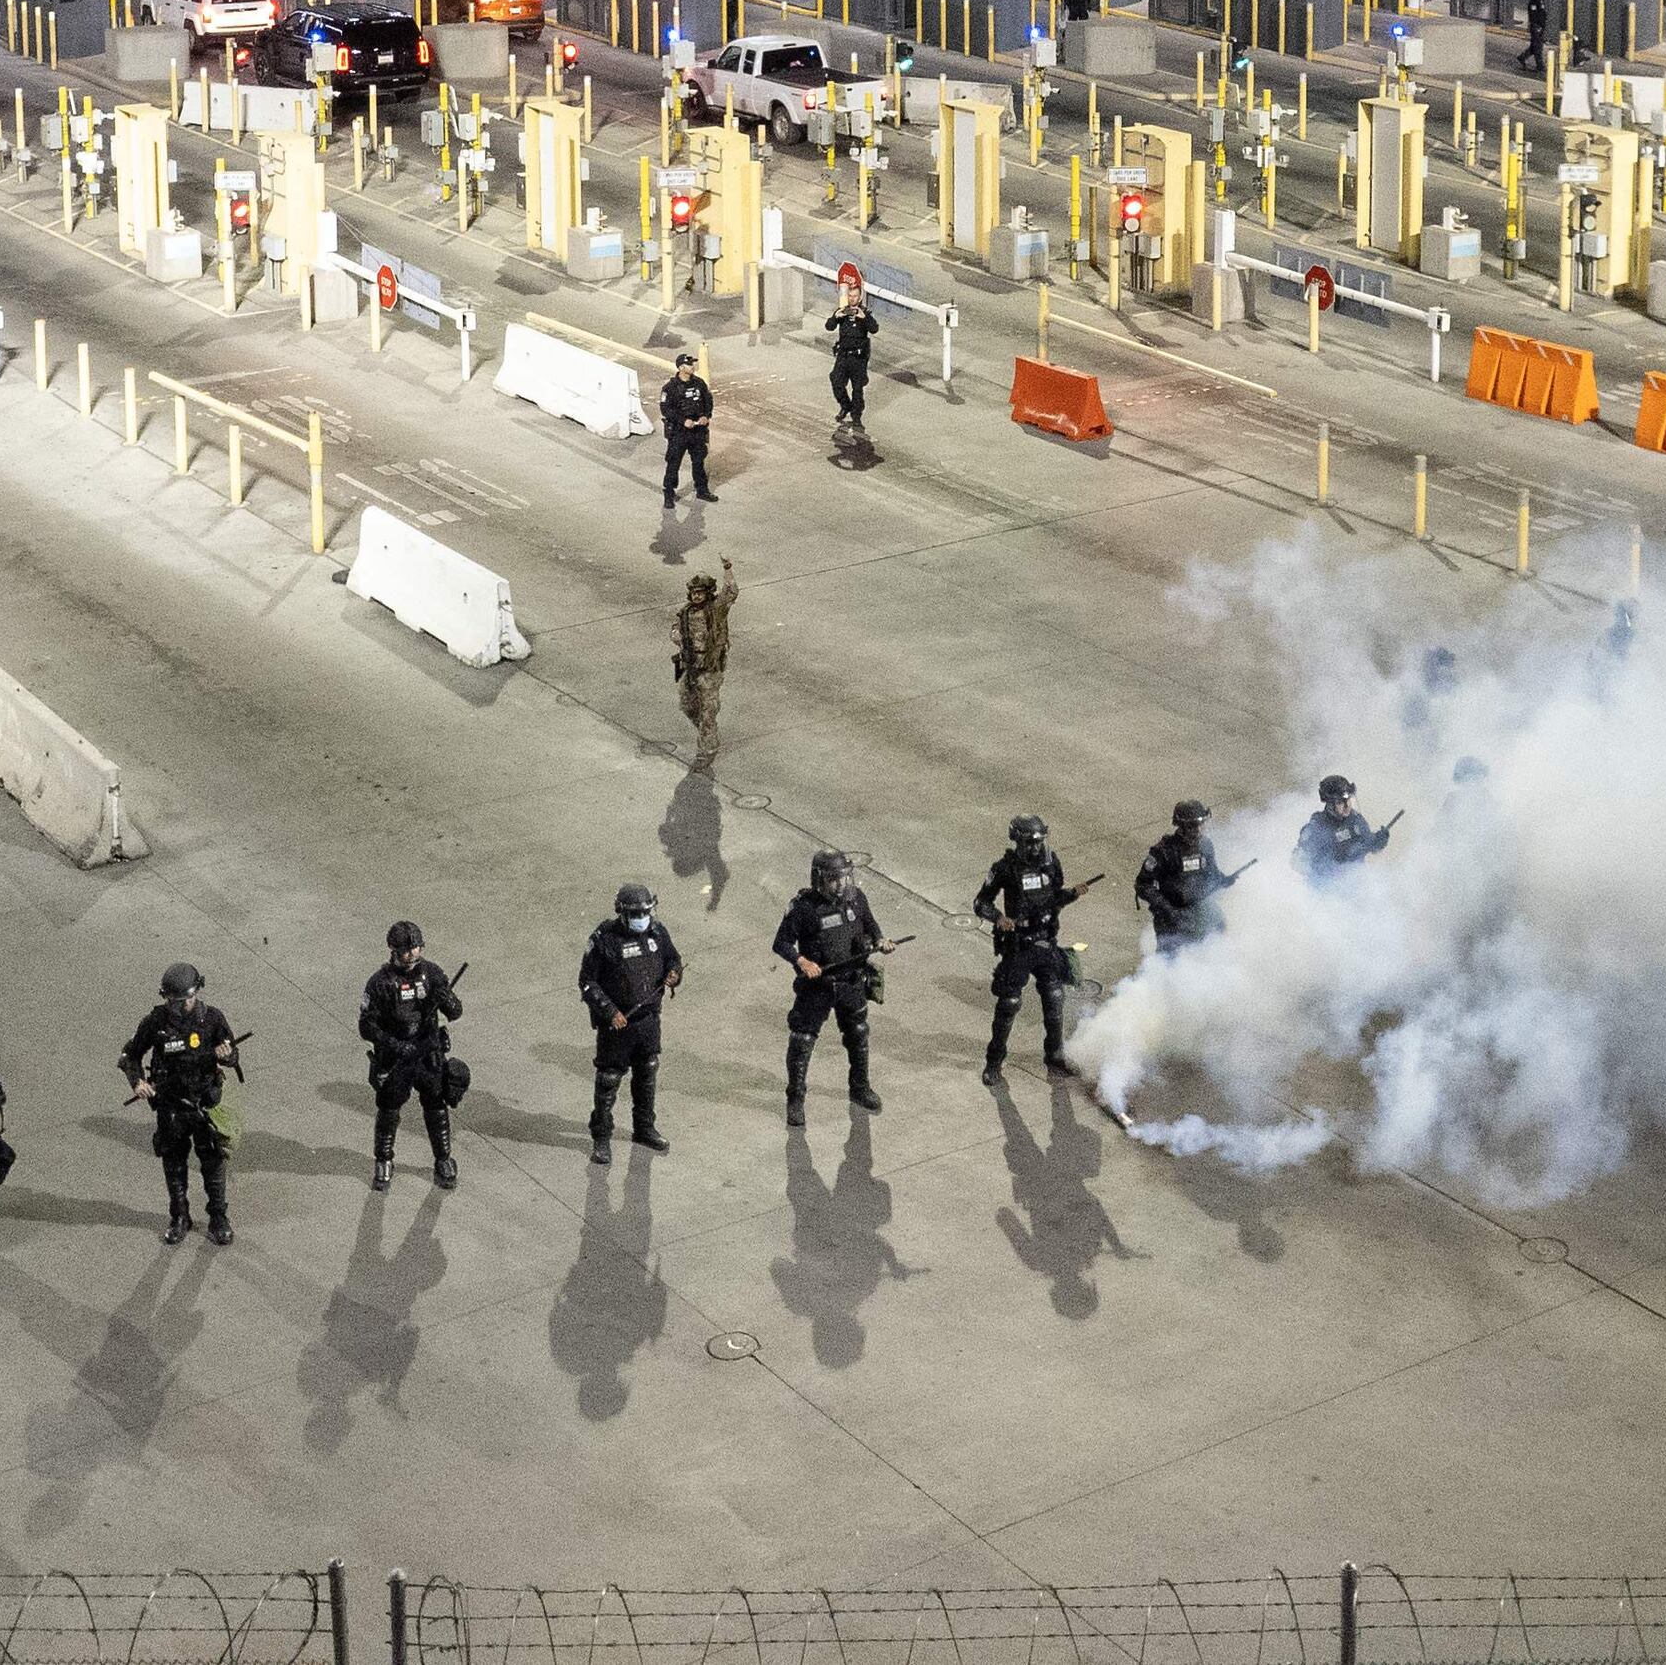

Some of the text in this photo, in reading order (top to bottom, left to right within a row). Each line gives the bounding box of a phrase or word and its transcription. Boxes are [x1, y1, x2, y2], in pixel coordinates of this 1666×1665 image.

[842, 274, 857, 286] STOP
[335, 458, 531, 529] LTO
[623, 946, 641, 954] CBP
[164, 1040, 185, 1049] CBP
